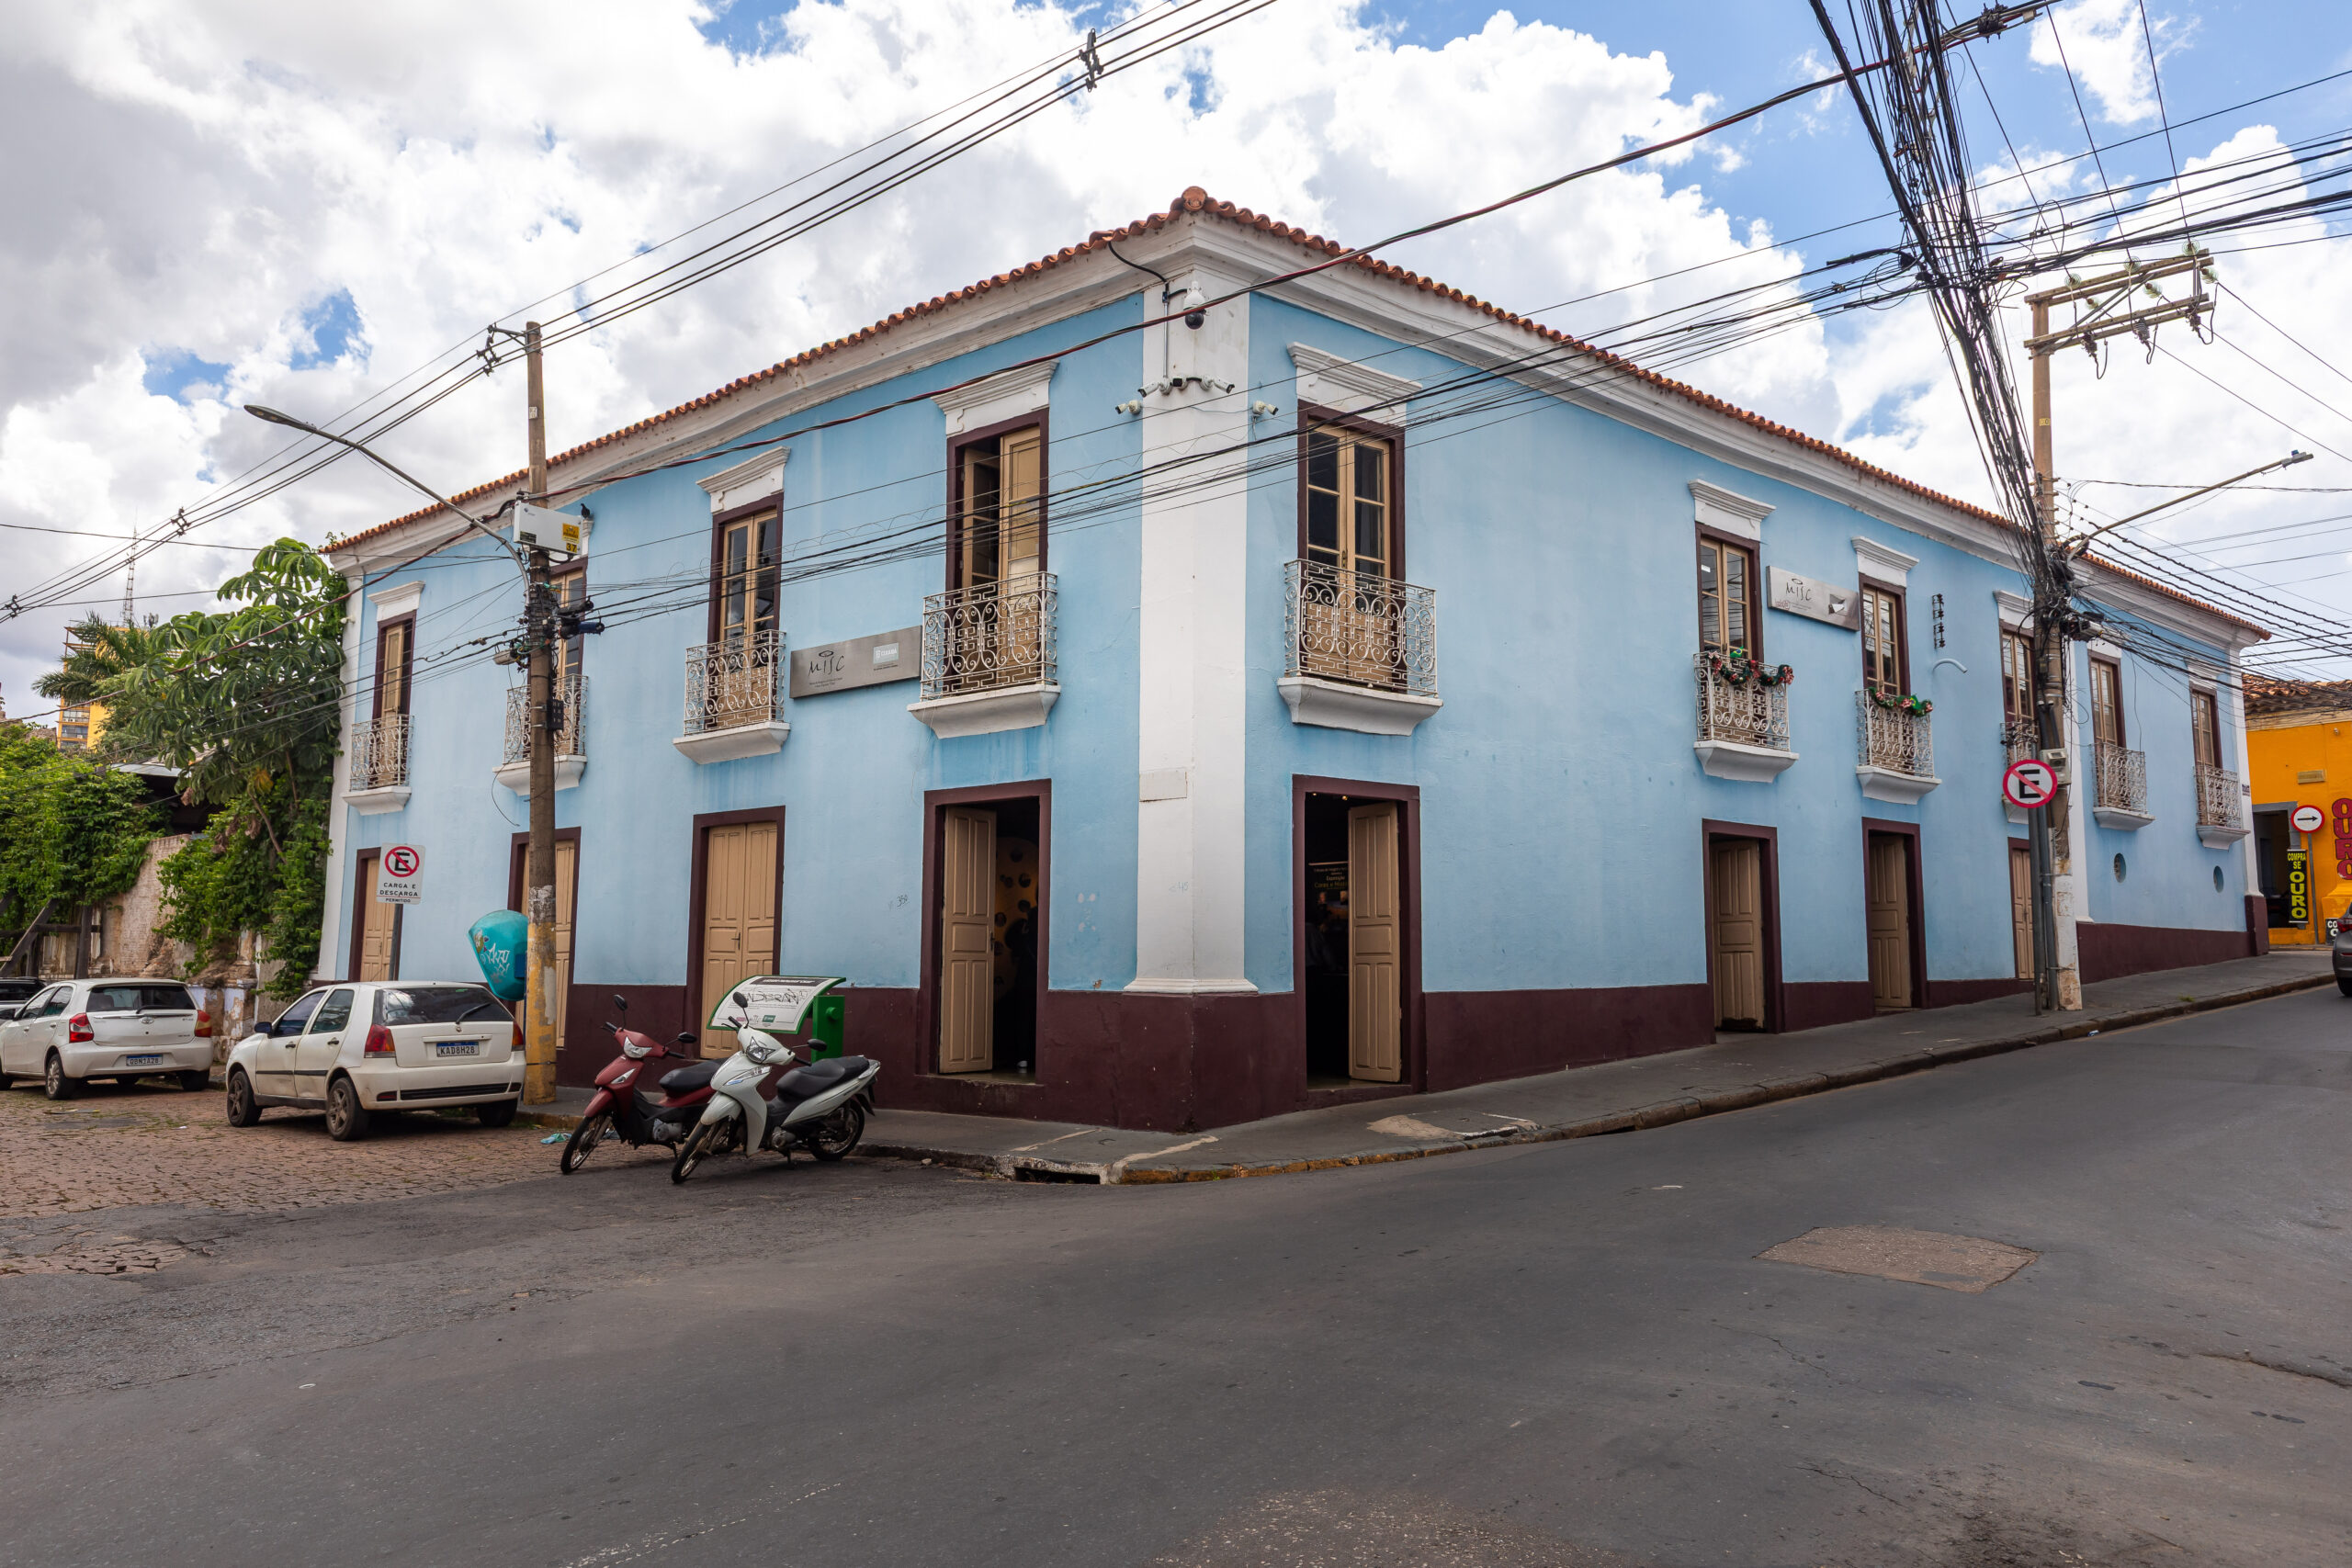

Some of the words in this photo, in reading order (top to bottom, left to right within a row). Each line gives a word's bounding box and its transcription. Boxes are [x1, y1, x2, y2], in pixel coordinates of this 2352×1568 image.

[566, 542, 578, 553] 37
[2018, 769, 2041, 799] E
[394, 852, 411, 872] E
[2288, 852, 2306, 862] COMPRA
[2292, 861, 2301, 870] SE
[2290, 871, 2307, 919] OURO
